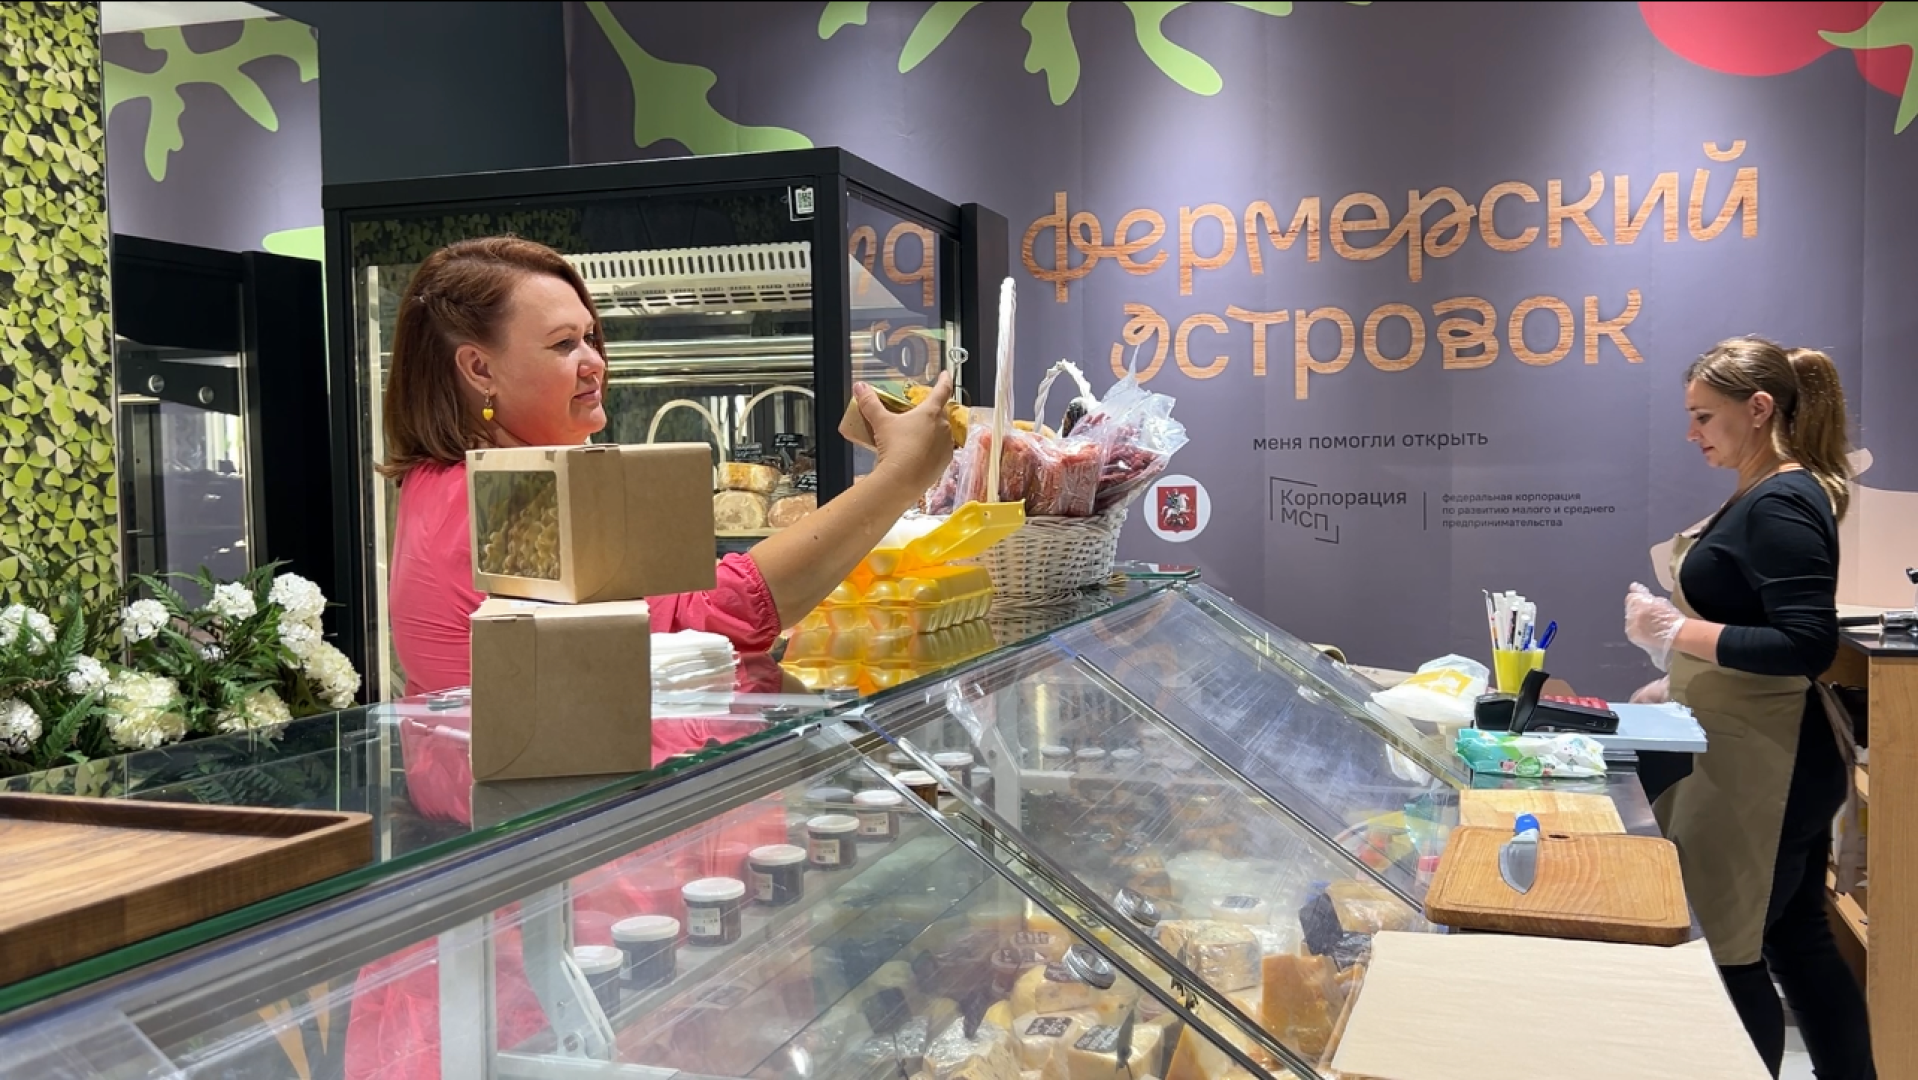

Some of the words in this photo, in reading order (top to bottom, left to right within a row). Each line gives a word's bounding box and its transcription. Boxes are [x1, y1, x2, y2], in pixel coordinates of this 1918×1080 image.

[1023, 140, 1758, 303] фермерский
[1111, 289, 1643, 400] островок
[1253, 436, 1301, 450] меня
[1309, 434, 1396, 449] помогли
[1402, 432, 1489, 450] открыть
[1280, 489, 1407, 509] Корпорация
[1442, 493, 1513, 503] федеральная
[1515, 492, 1581, 502] корпорация
[1281, 507, 1329, 531] МСП
[1442, 506, 1455, 514] по
[1457, 505, 1510, 515] развитию
[1512, 505, 1551, 514] малого
[1554, 506, 1560, 514] и
[1563, 504, 1616, 515] среднего
[1442, 517, 1563, 529] предпринимательства
